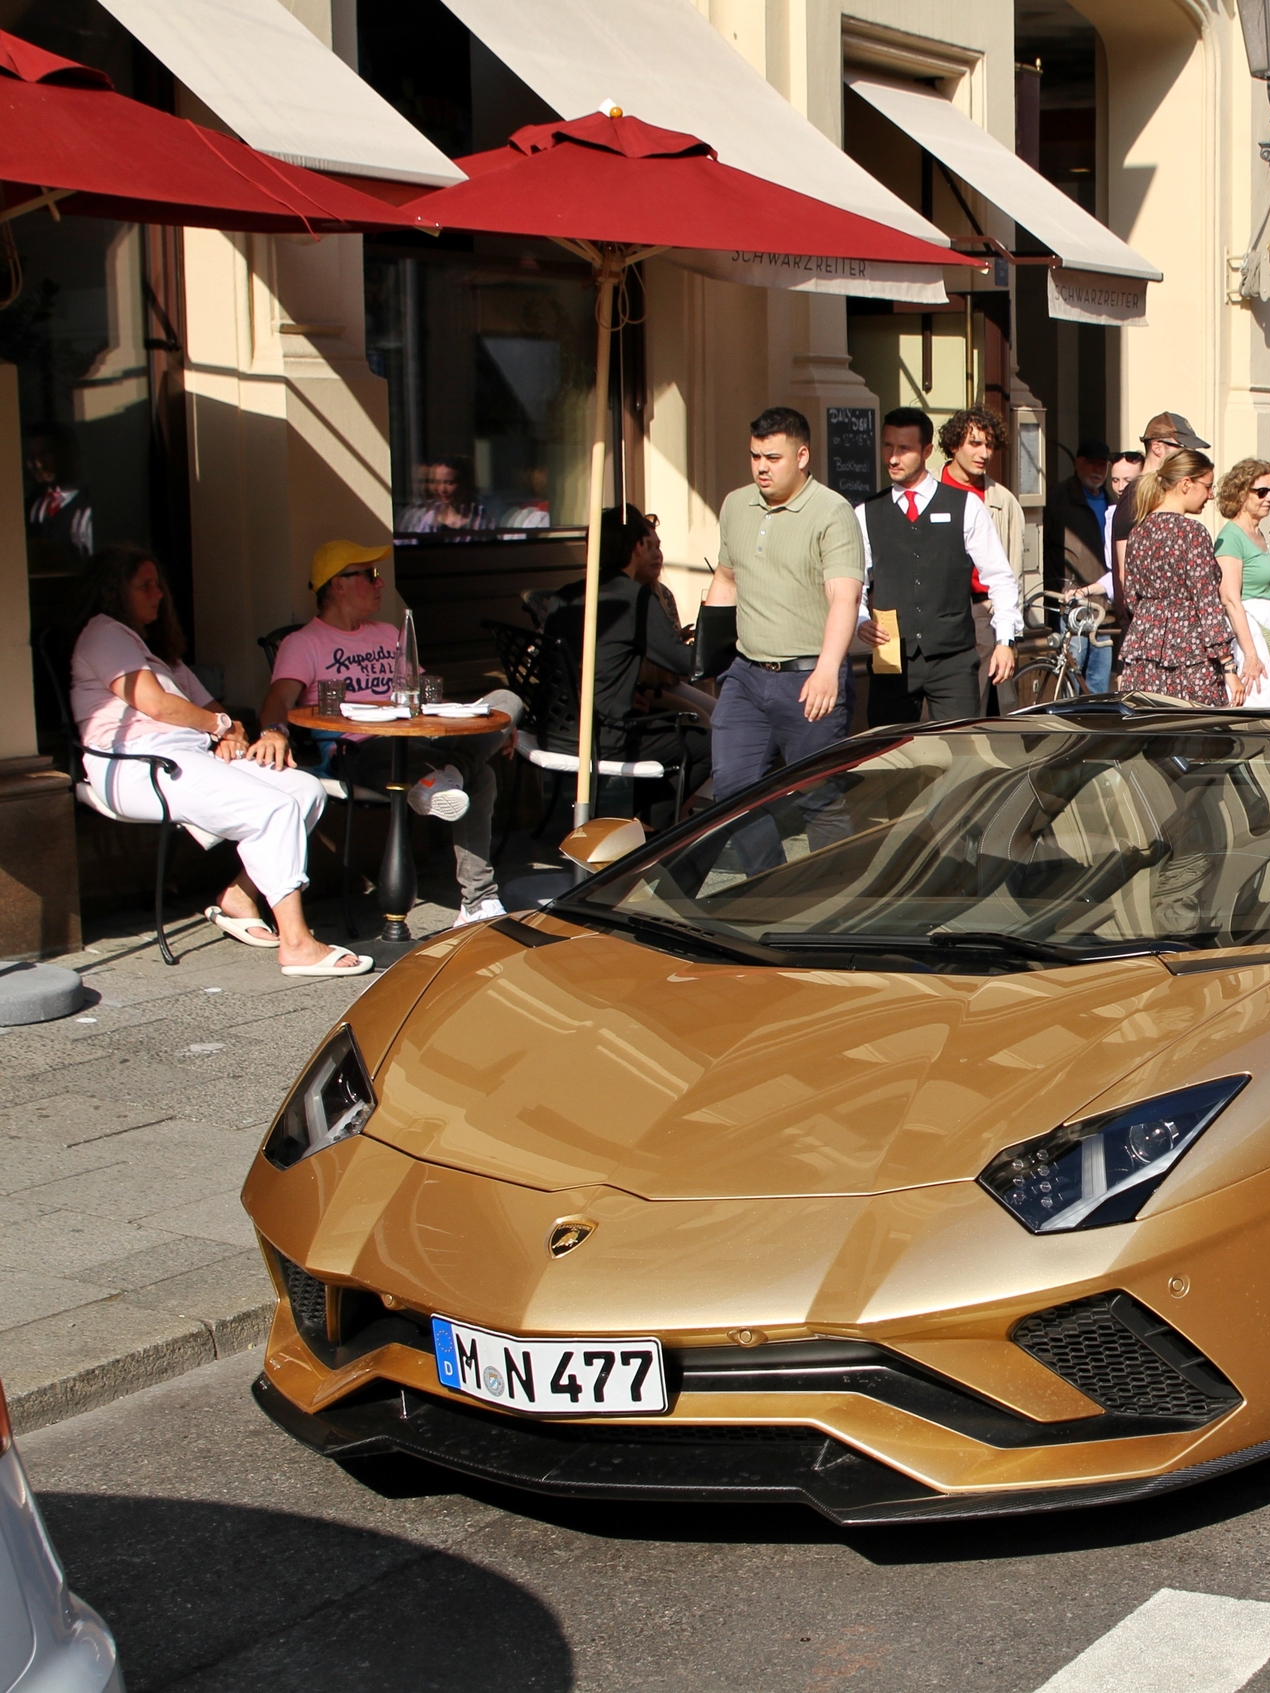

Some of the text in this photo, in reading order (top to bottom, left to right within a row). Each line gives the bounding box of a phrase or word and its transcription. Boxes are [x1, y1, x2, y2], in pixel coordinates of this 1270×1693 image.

[1054, 284, 1140, 309] SCHWARZREITER
[443, 1360, 453, 1376] D
[550, 1350, 654, 1403] 477
